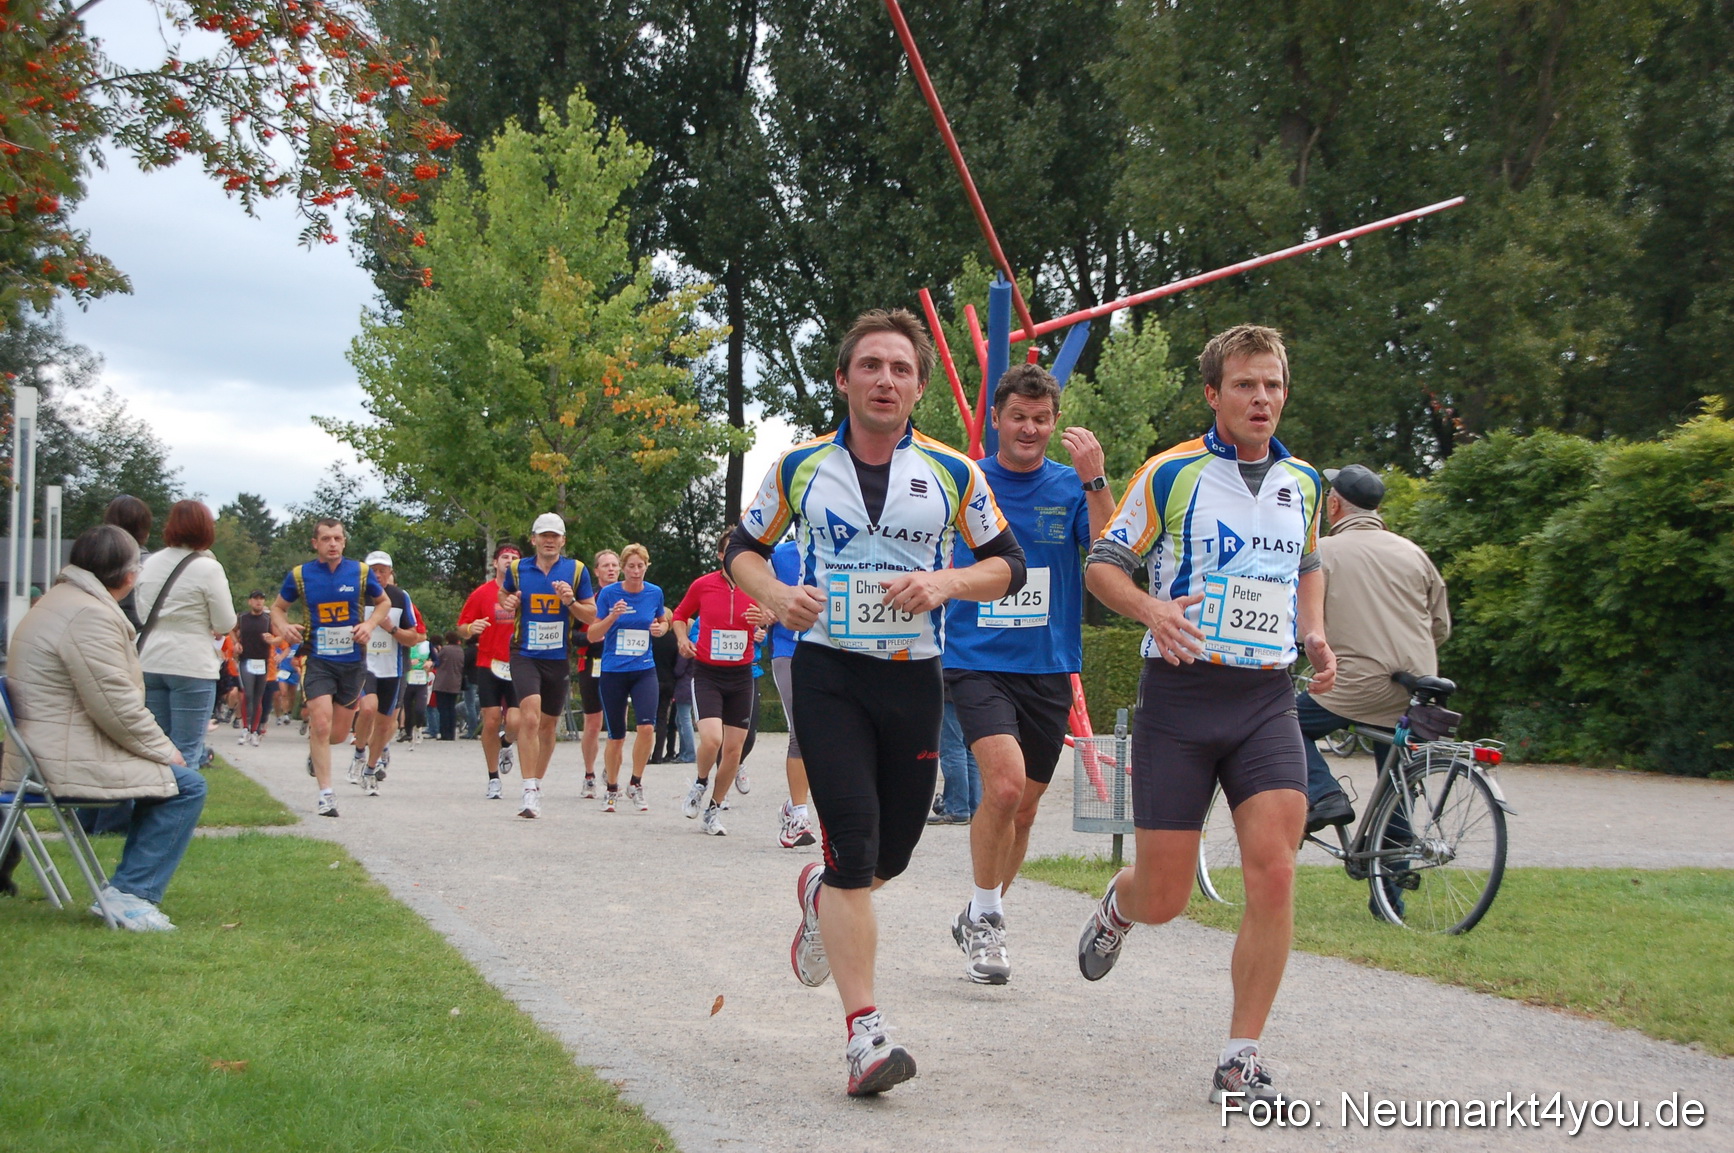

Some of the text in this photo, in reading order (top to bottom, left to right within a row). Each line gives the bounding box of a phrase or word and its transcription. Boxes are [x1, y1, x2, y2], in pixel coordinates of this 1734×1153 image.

[1124, 498, 1143, 526] TEC
[866, 524, 934, 544] PLAST
[1252, 536, 1301, 555] PLAST
[1232, 584, 1262, 602] Peter
[835, 601, 841, 612] B
[1208, 603, 1215, 614] B
[857, 602, 914, 623] 3215
[1229, 608, 1279, 634] 3222
[328, 637, 351, 645] 2142
[538, 631, 560, 640] 2460
[372, 641, 388, 649] 698
[626, 639, 646, 647] 3742
[722, 641, 744, 650] 3130
